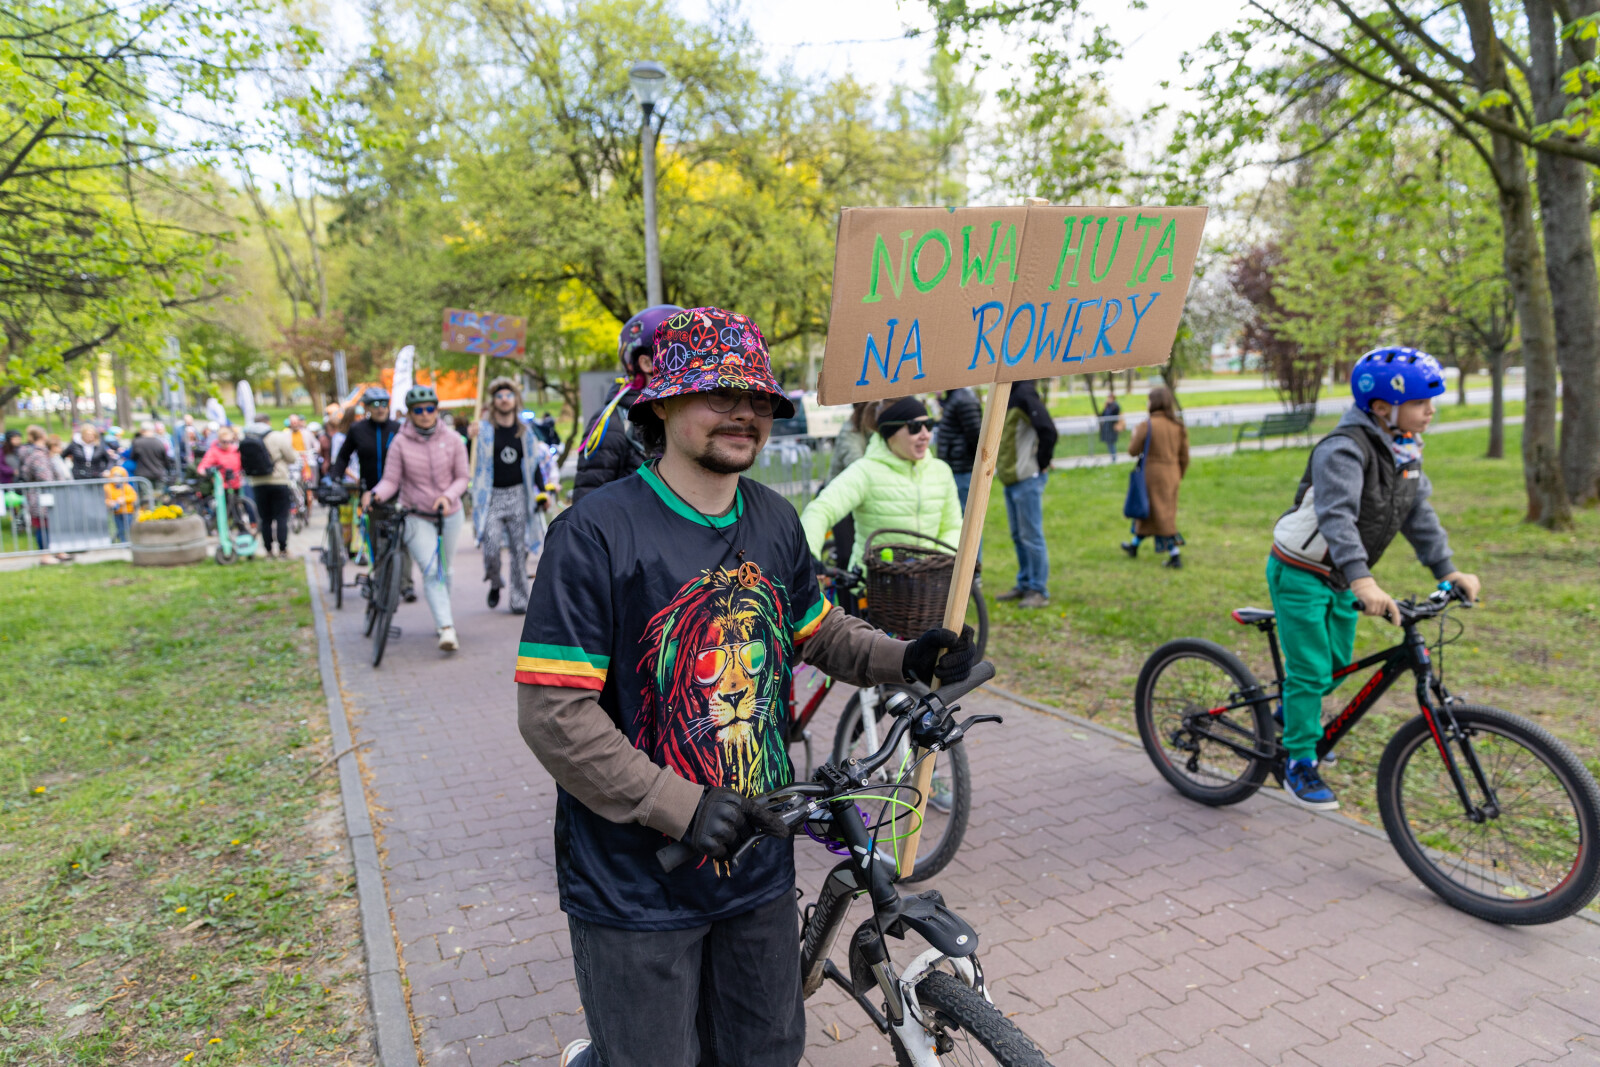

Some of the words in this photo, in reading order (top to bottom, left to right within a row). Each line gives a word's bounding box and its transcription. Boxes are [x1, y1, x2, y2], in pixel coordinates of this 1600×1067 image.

[861, 221, 1019, 303] NOWA
[1048, 213, 1177, 291] HUTA
[856, 318, 926, 386] NA
[967, 292, 1161, 370] ROWERY
